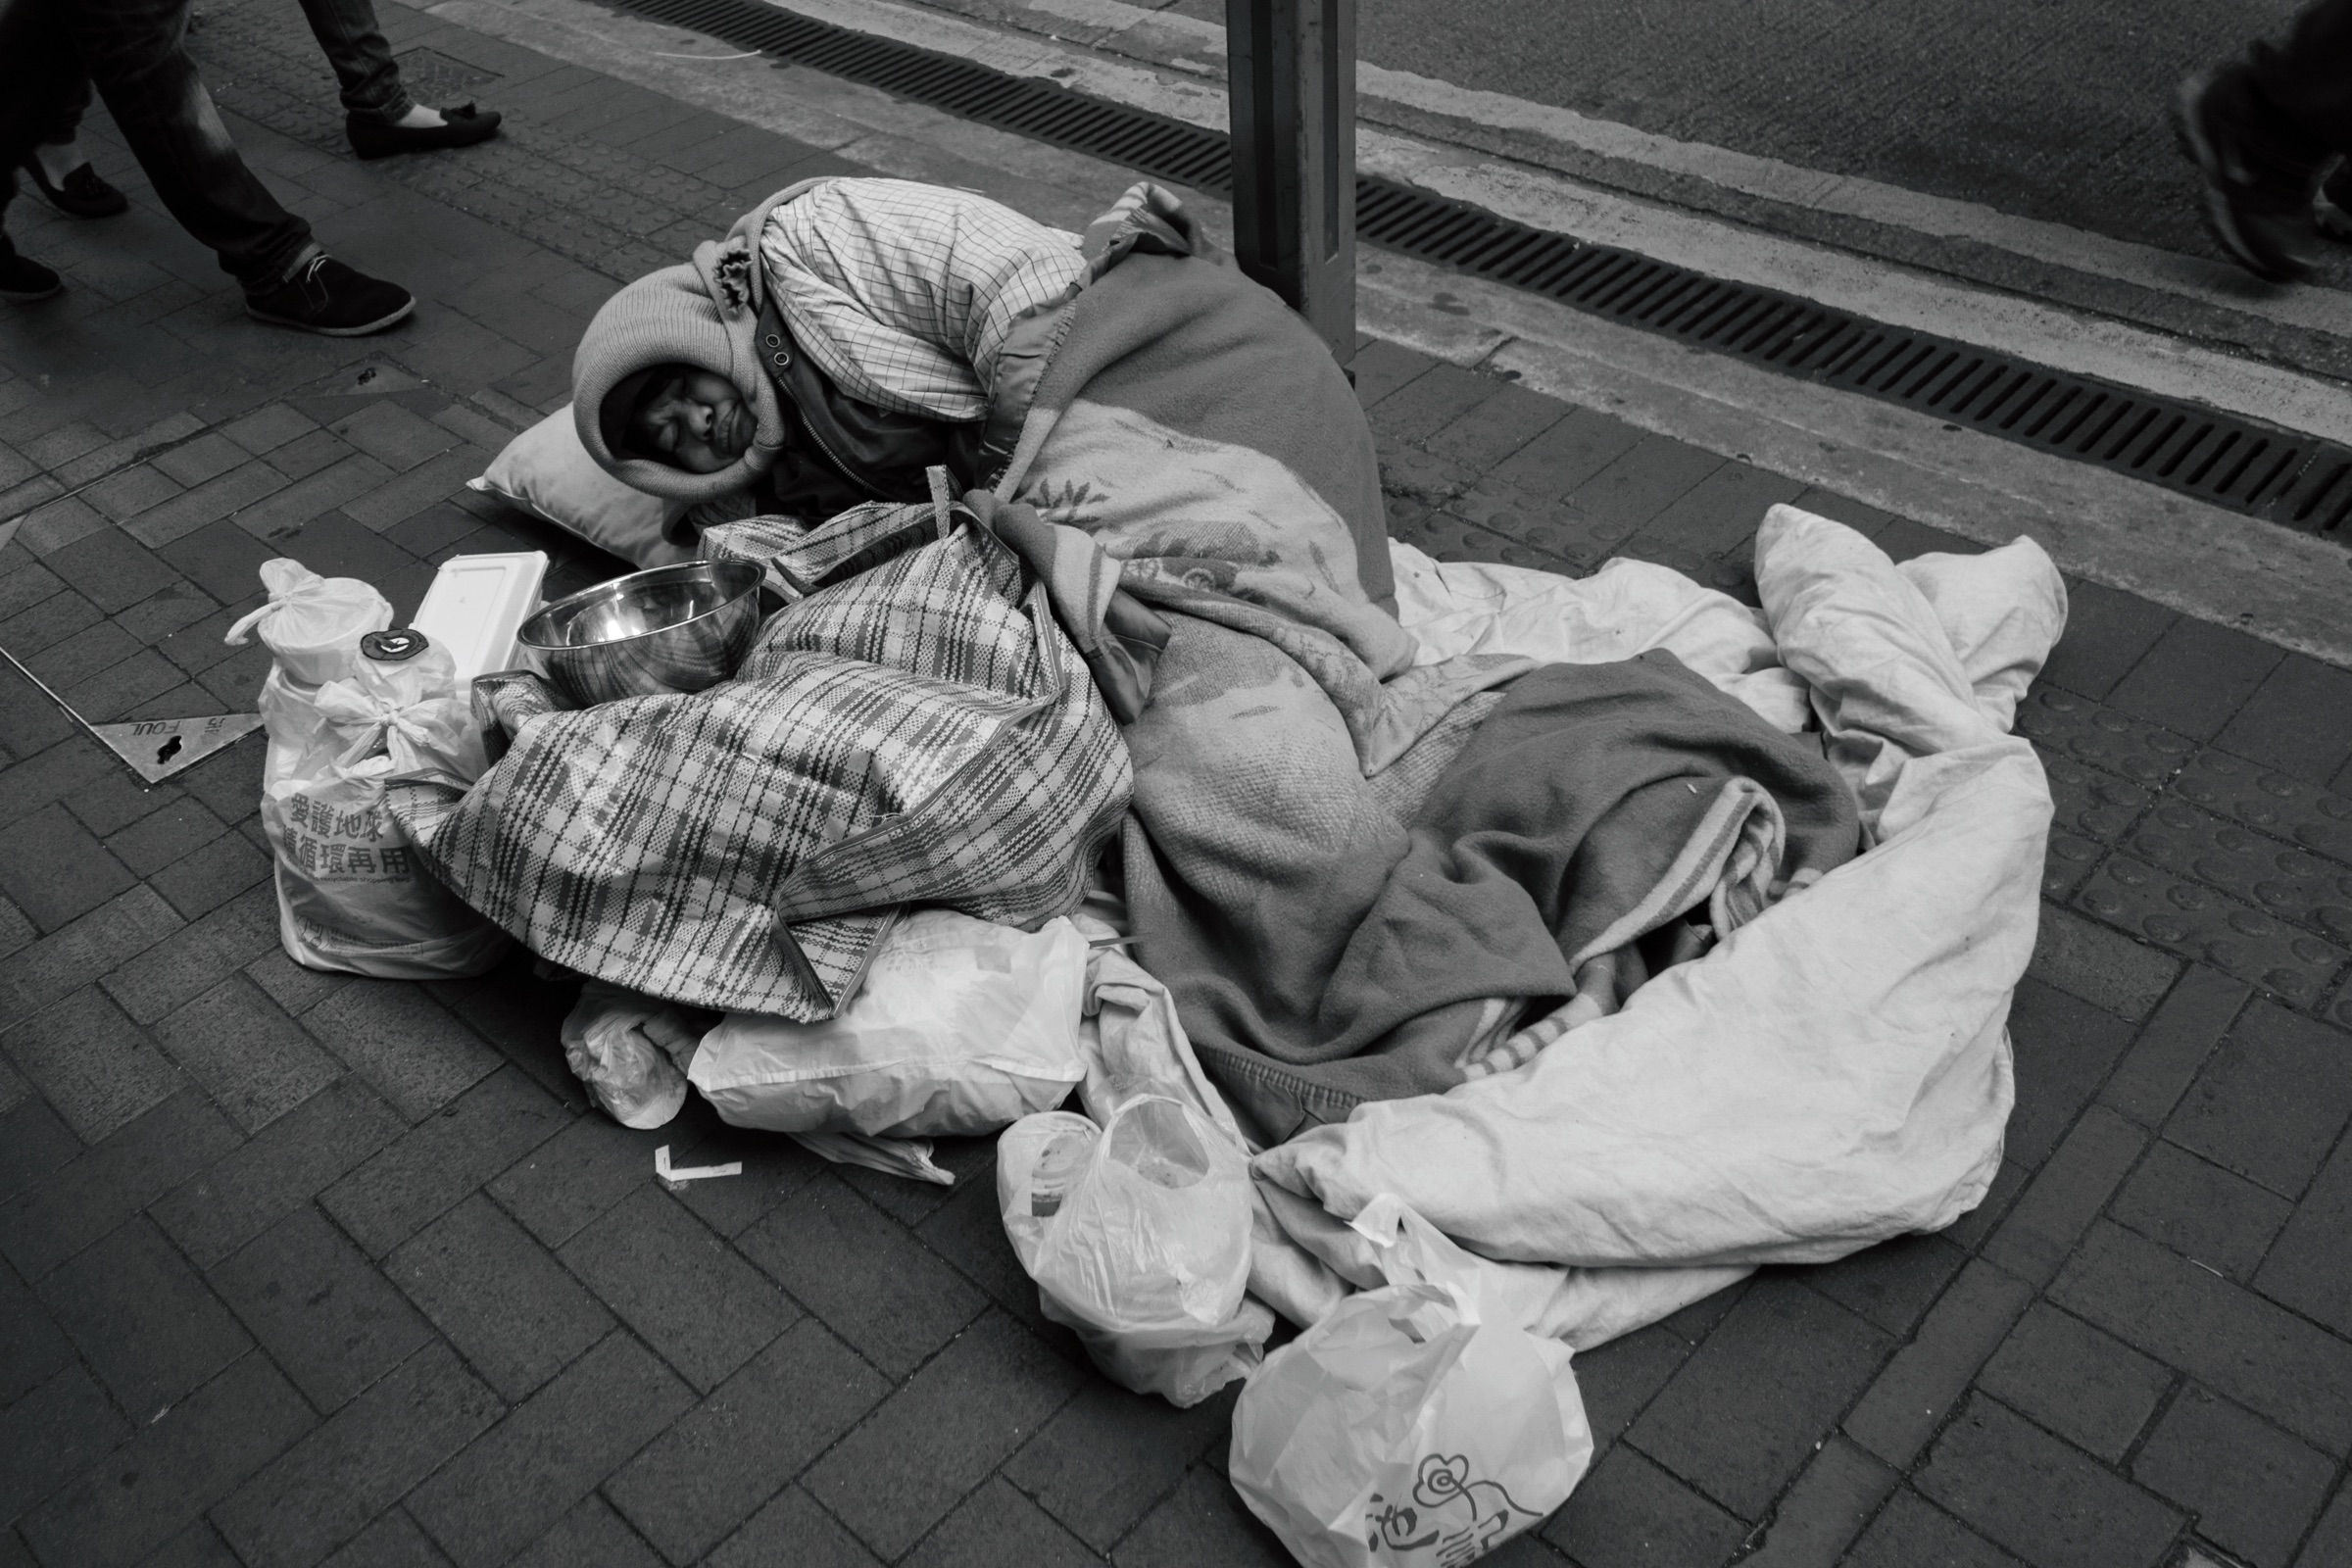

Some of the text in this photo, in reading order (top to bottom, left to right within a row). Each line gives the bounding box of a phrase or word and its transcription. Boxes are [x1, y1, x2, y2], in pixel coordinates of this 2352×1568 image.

[129, 720, 181, 735] FOUL
[291, 792, 383, 843] 愛護地球
